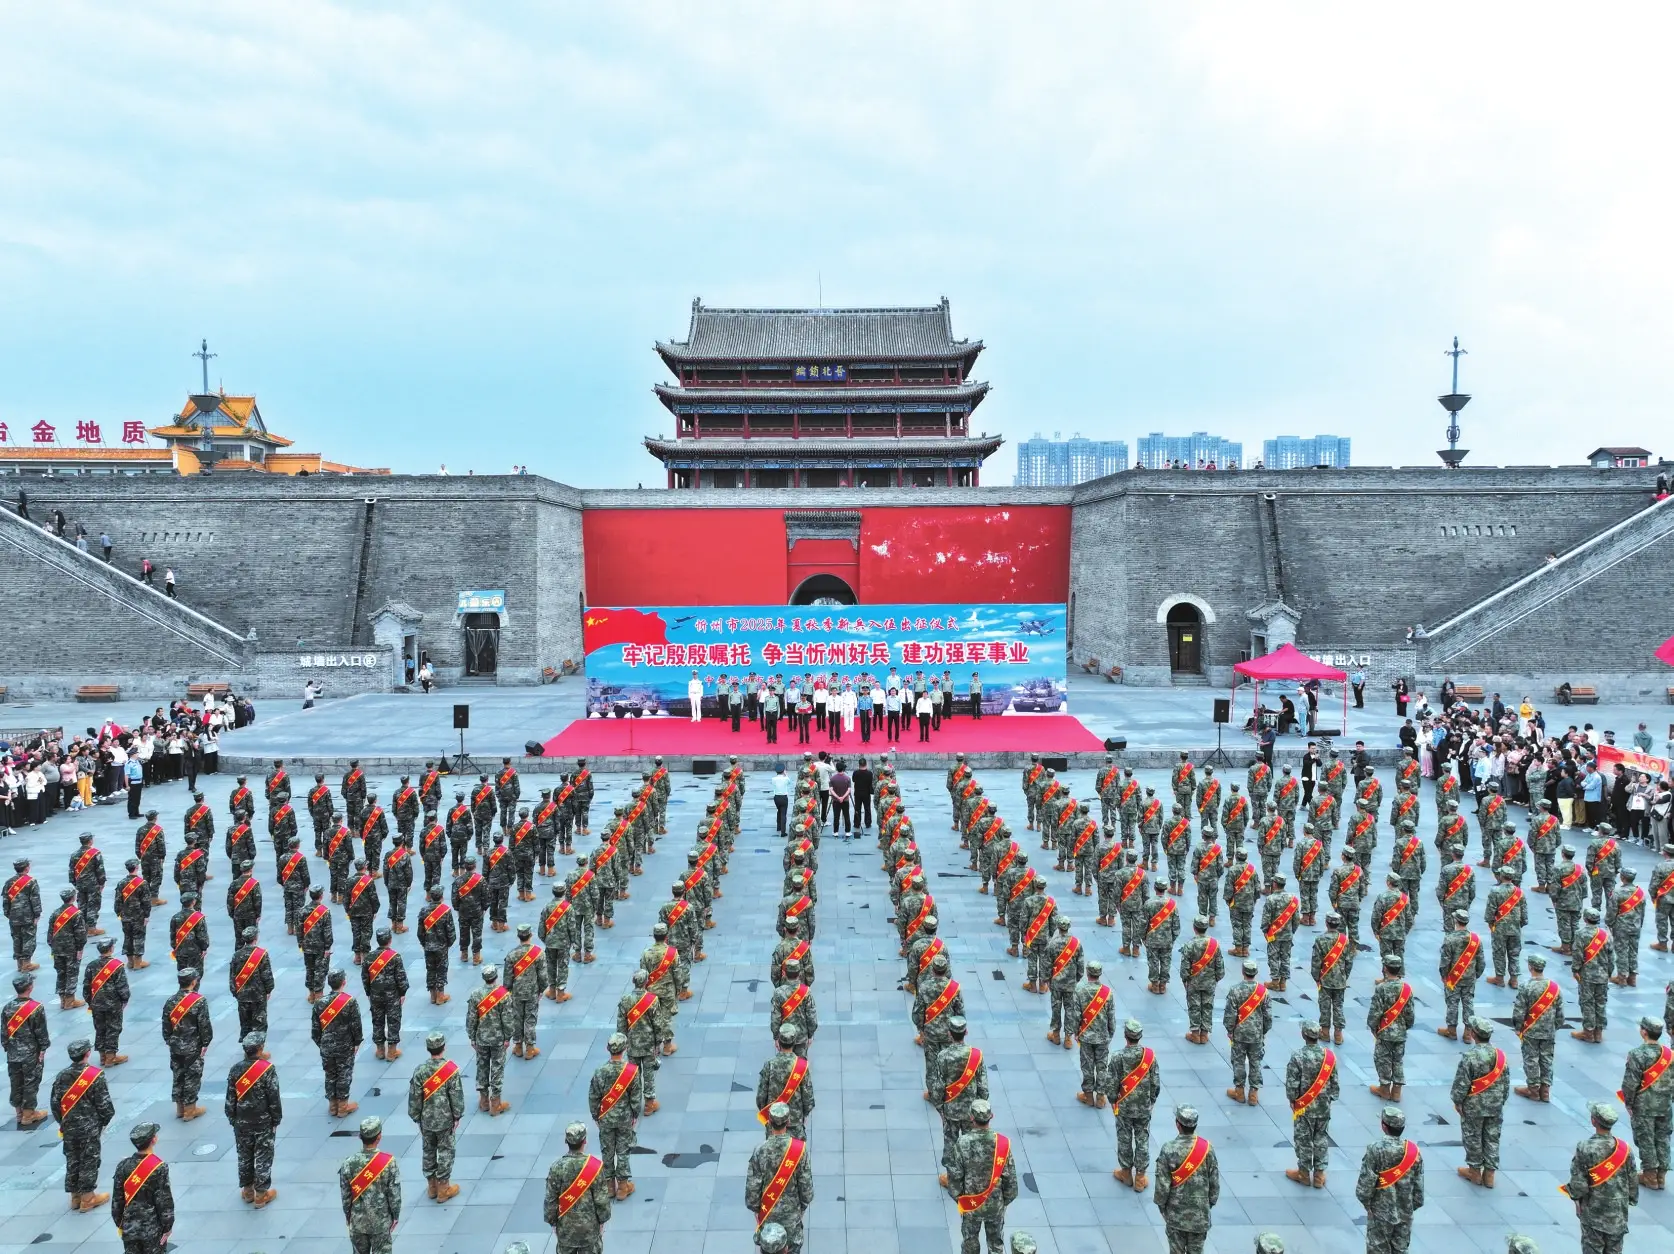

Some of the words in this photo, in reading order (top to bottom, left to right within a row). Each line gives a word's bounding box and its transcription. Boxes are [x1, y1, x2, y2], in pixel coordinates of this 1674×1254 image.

[695, 616, 960, 635] 忻州市2025年夏秋季新兵入伍出征仪式
[299, 654, 362, 668] 城墙出入口
[622, 642, 751, 667] 牢记殷殷嘱托
[762, 642, 890, 666] 争当忻州好兵
[902, 641, 1029, 665] 建功强军事业
